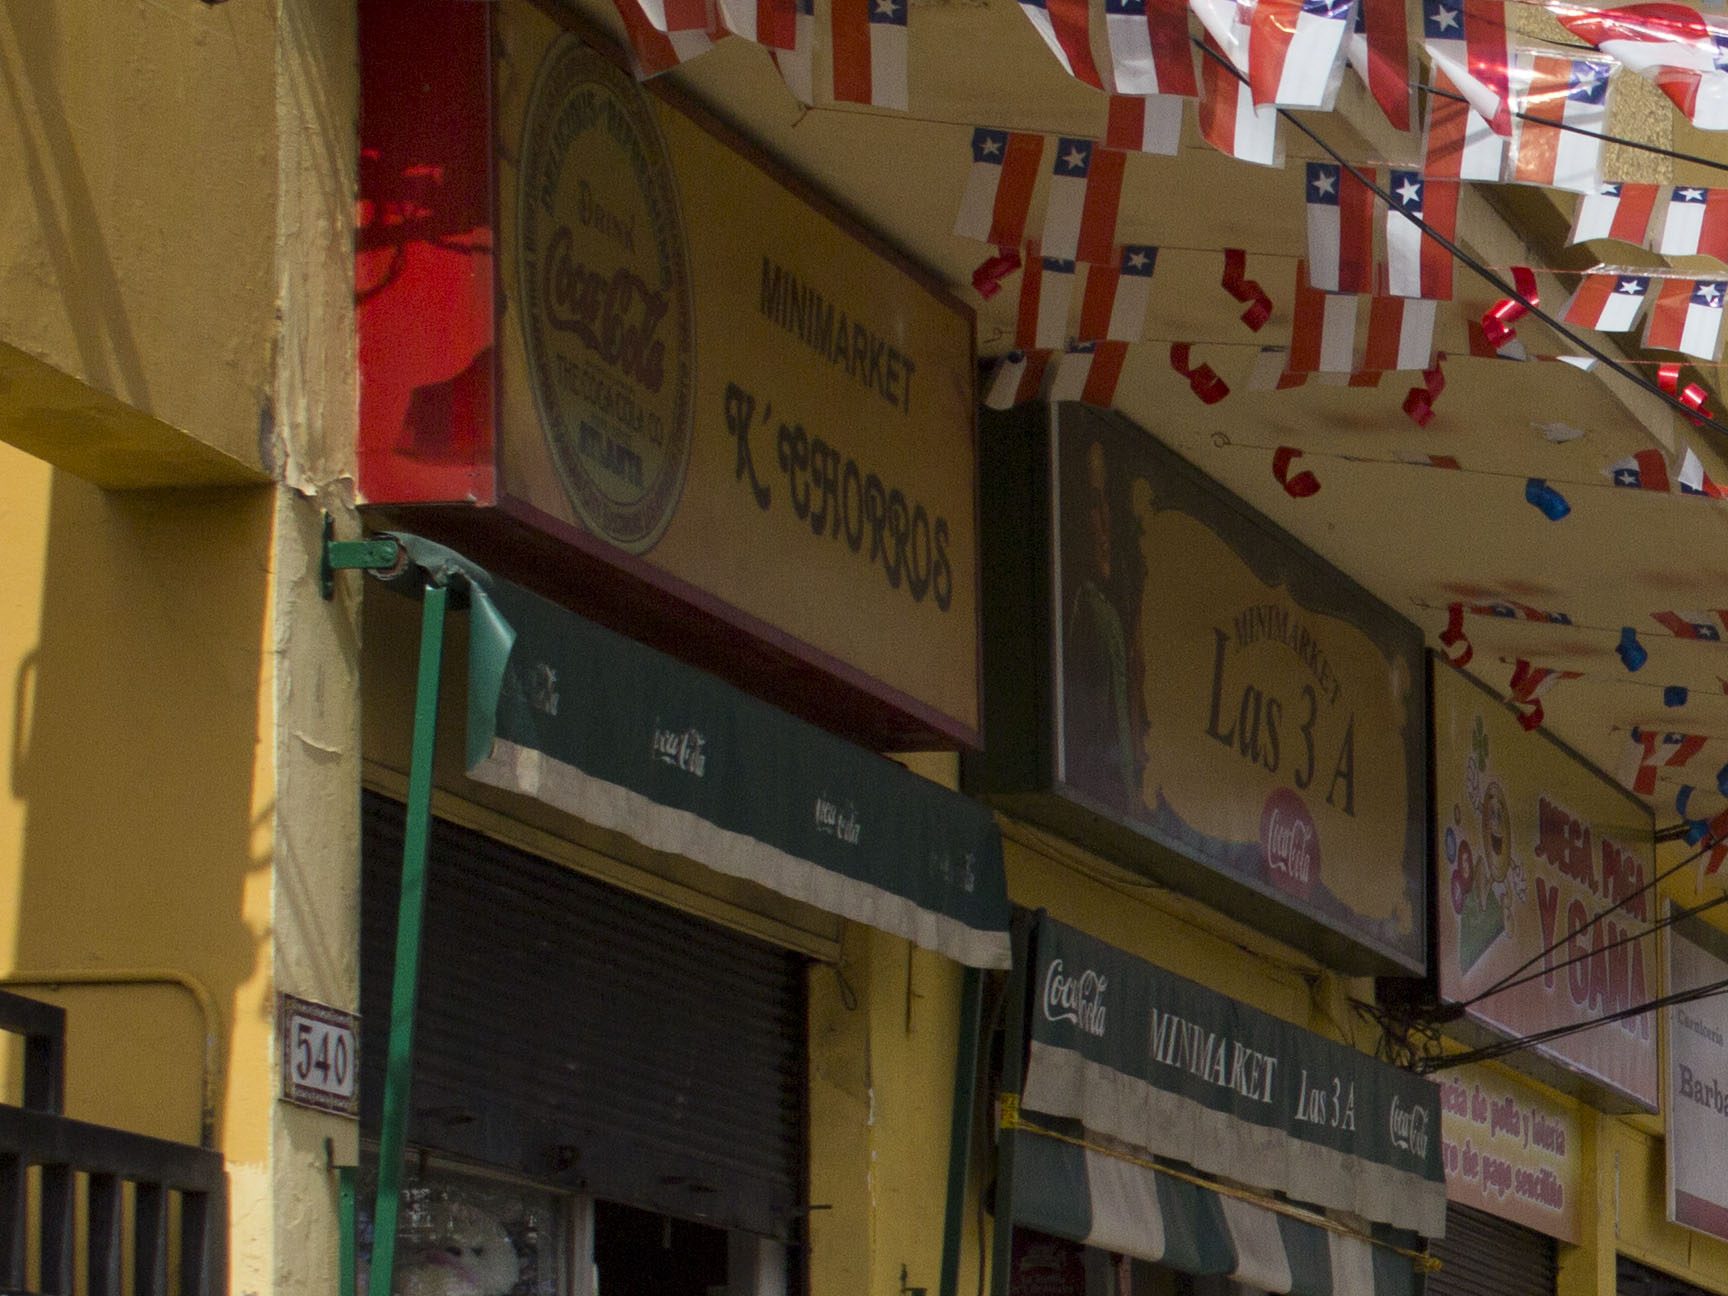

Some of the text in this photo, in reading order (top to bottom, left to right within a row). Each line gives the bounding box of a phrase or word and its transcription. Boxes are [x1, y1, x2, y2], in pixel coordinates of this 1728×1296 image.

[759, 256, 915, 416] MINIMARKET
[1234, 603, 1340, 704] MINIMARKET
[1205, 626, 1355, 818] Las 3 A
[1601, 838, 1649, 923] PAGA
[1535, 876, 1652, 1043] Y GANA
[294, 1023, 349, 1087] 540
[1294, 1071, 1326, 1127] Las
[1331, 1077, 1341, 1125] 3
[1344, 1082, 1356, 1131] A
[1471, 1084, 1488, 1125] de
[1490, 1096, 1521, 1138] polla
[1522, 1113, 1529, 1150] y
[1462, 1138, 1479, 1179] de
[1482, 1154, 1512, 1198] pago
